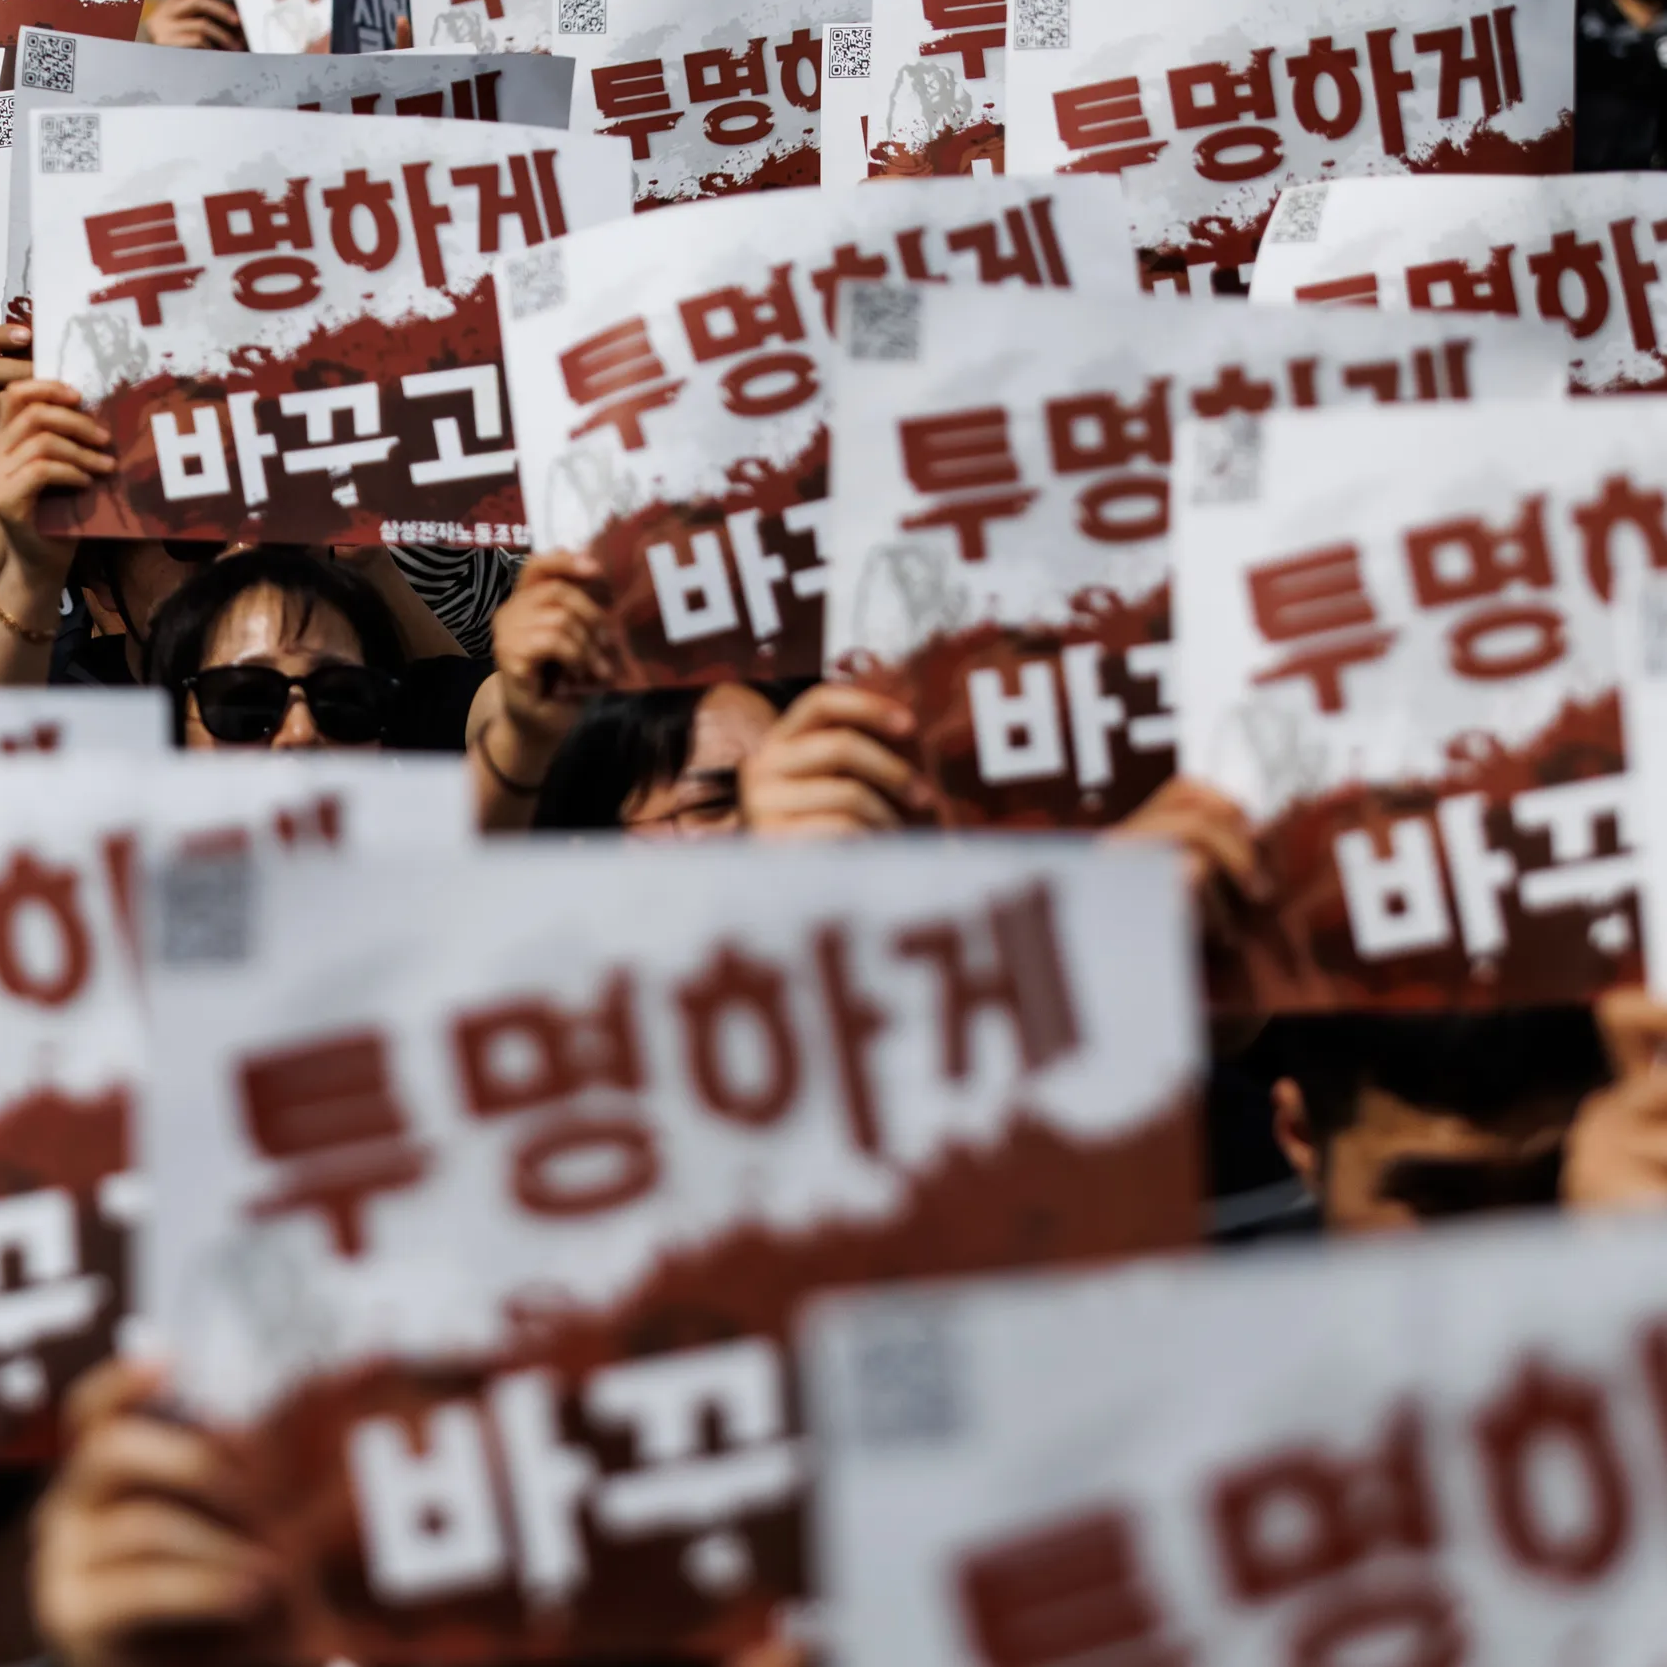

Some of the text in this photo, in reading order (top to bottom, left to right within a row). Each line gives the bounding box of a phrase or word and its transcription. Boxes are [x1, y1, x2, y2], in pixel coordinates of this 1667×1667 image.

[1052, 5, 1524, 183] 투명하게
[84, 148, 570, 326] 투명하게
[150, 364, 522, 512] 바꾸고
[647, 491, 829, 645] 바
[229, 880, 1088, 1262] 투명하게
